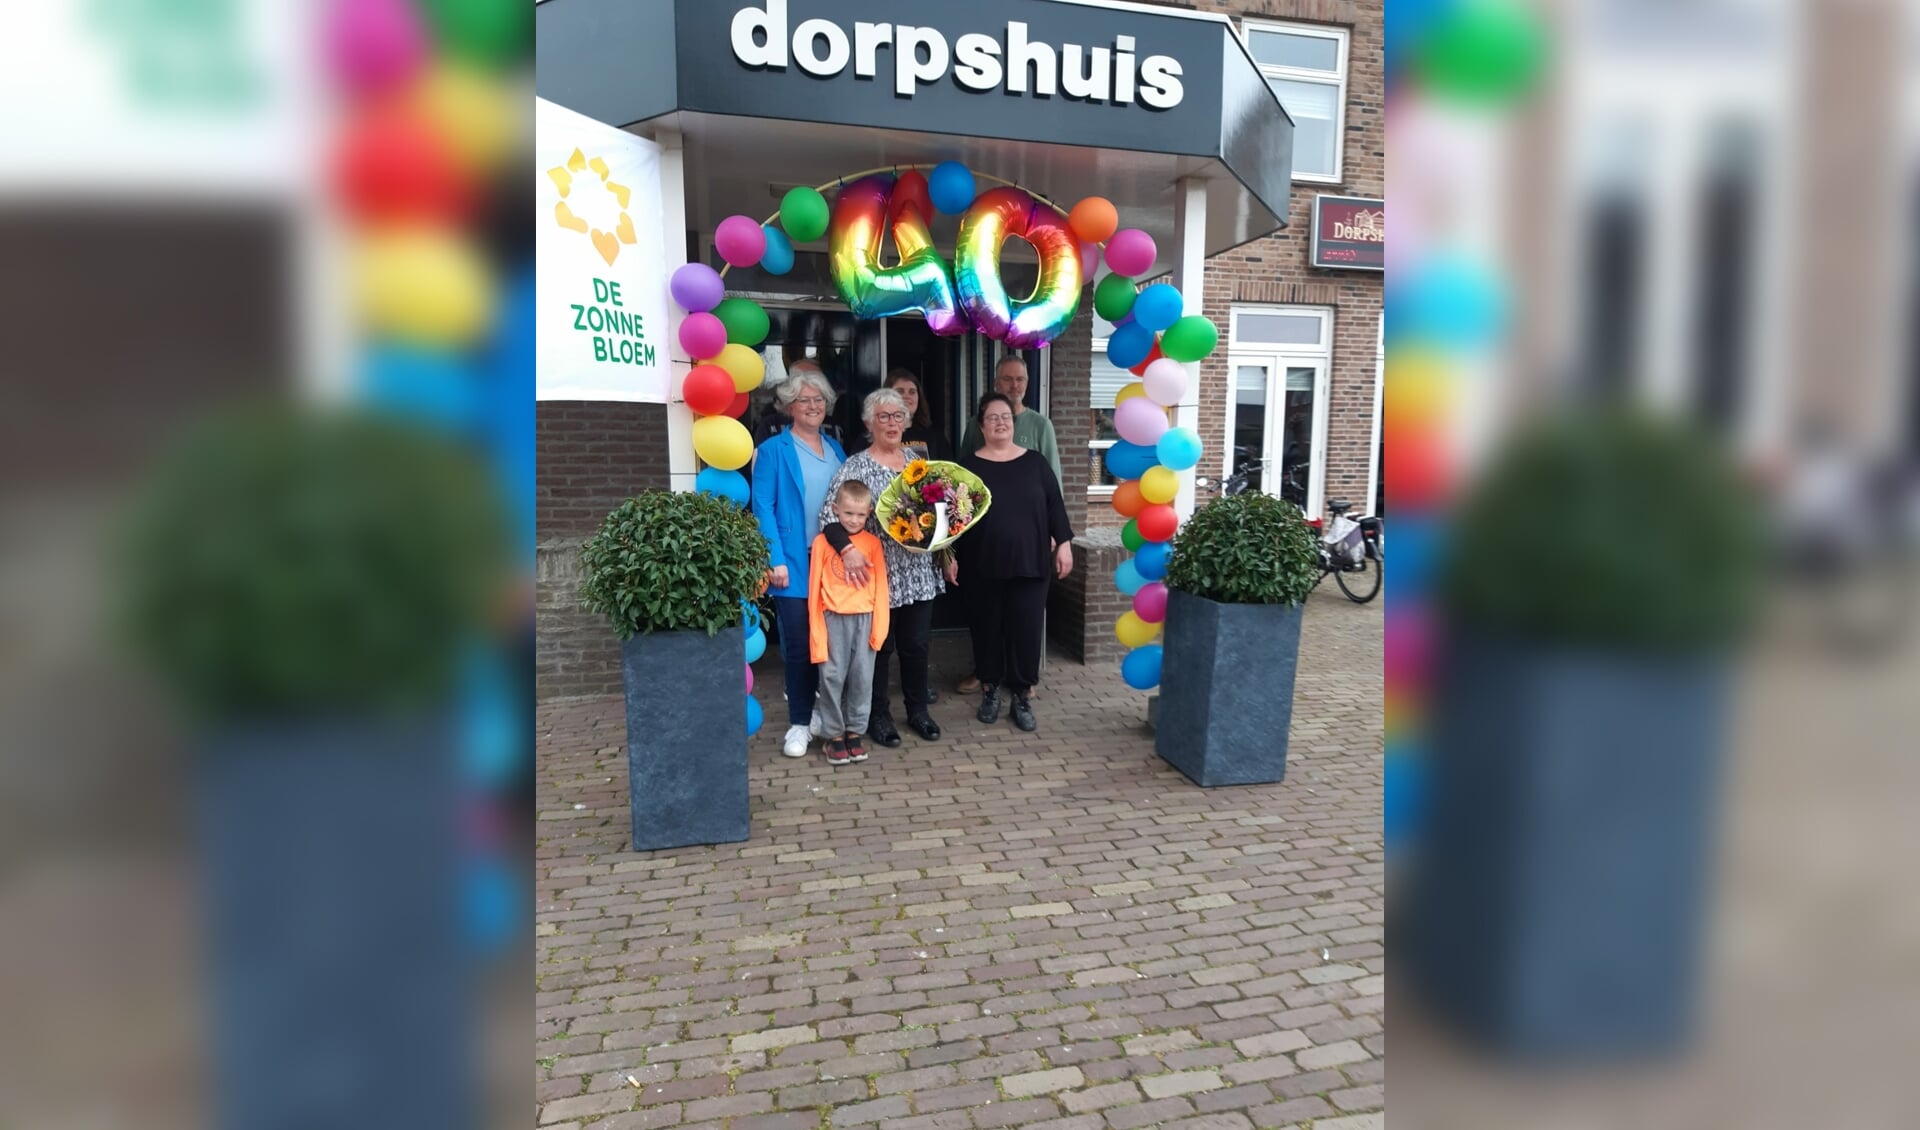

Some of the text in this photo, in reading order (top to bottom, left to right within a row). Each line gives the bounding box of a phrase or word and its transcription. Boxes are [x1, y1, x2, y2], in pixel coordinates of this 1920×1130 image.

[730, 0, 1185, 109] dorpshuis
[592, 277, 623, 307] DE
[570, 303, 645, 339] ZONNE
[592, 335, 655, 368] BLOEM
